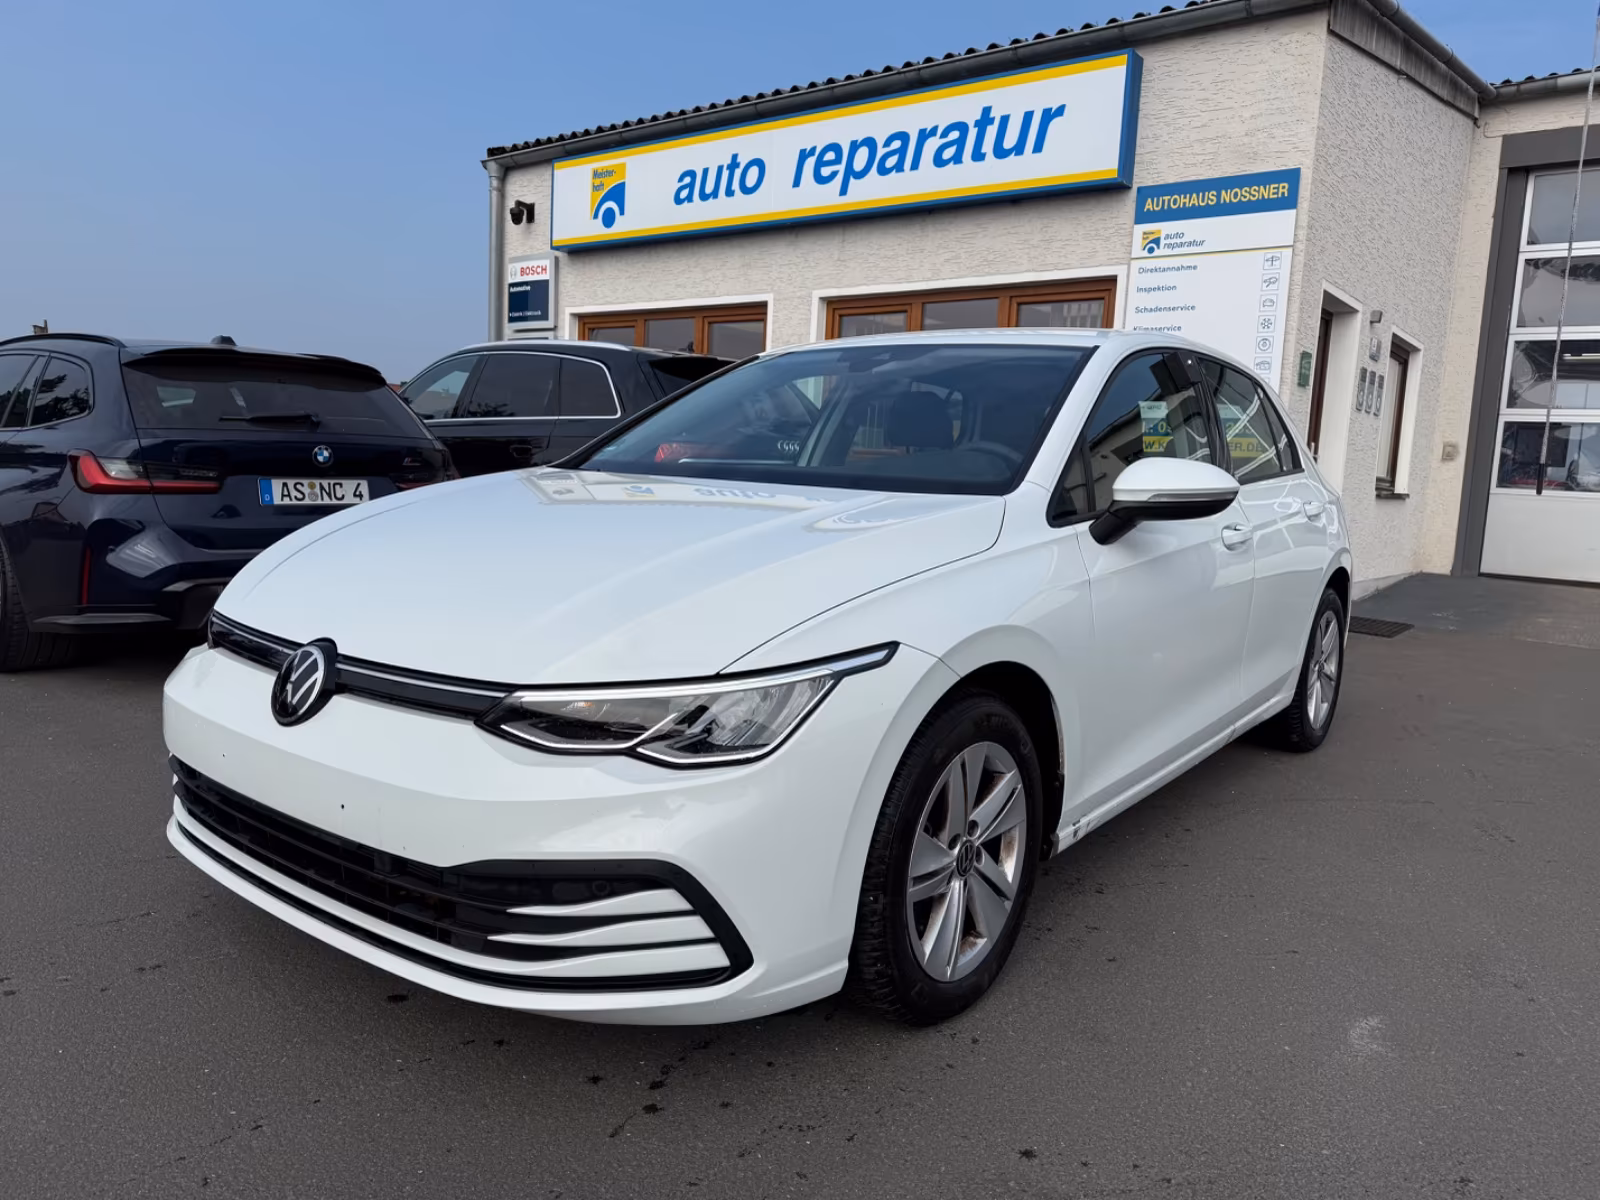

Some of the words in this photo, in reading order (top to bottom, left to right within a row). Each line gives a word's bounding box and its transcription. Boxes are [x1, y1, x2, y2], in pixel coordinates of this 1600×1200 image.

[673, 153, 766, 206] auto
[792, 103, 1066, 197] reparatur
[1143, 191, 1217, 212] AUTOHAUS
[1220, 183, 1289, 203] NOSSNER
[1163, 231, 1185, 241] auto
[1162, 238, 1206, 251] reparatur
[520, 264, 547, 277] BOSCH
[1138, 263, 1198, 275] Direktannahme
[1136, 284, 1177, 295] Inspektion
[1134, 303, 1196, 314] Schadenservice
[280, 482, 306, 502] AS
[319, 482, 345, 502] NC
[352, 482, 364, 501] 4
